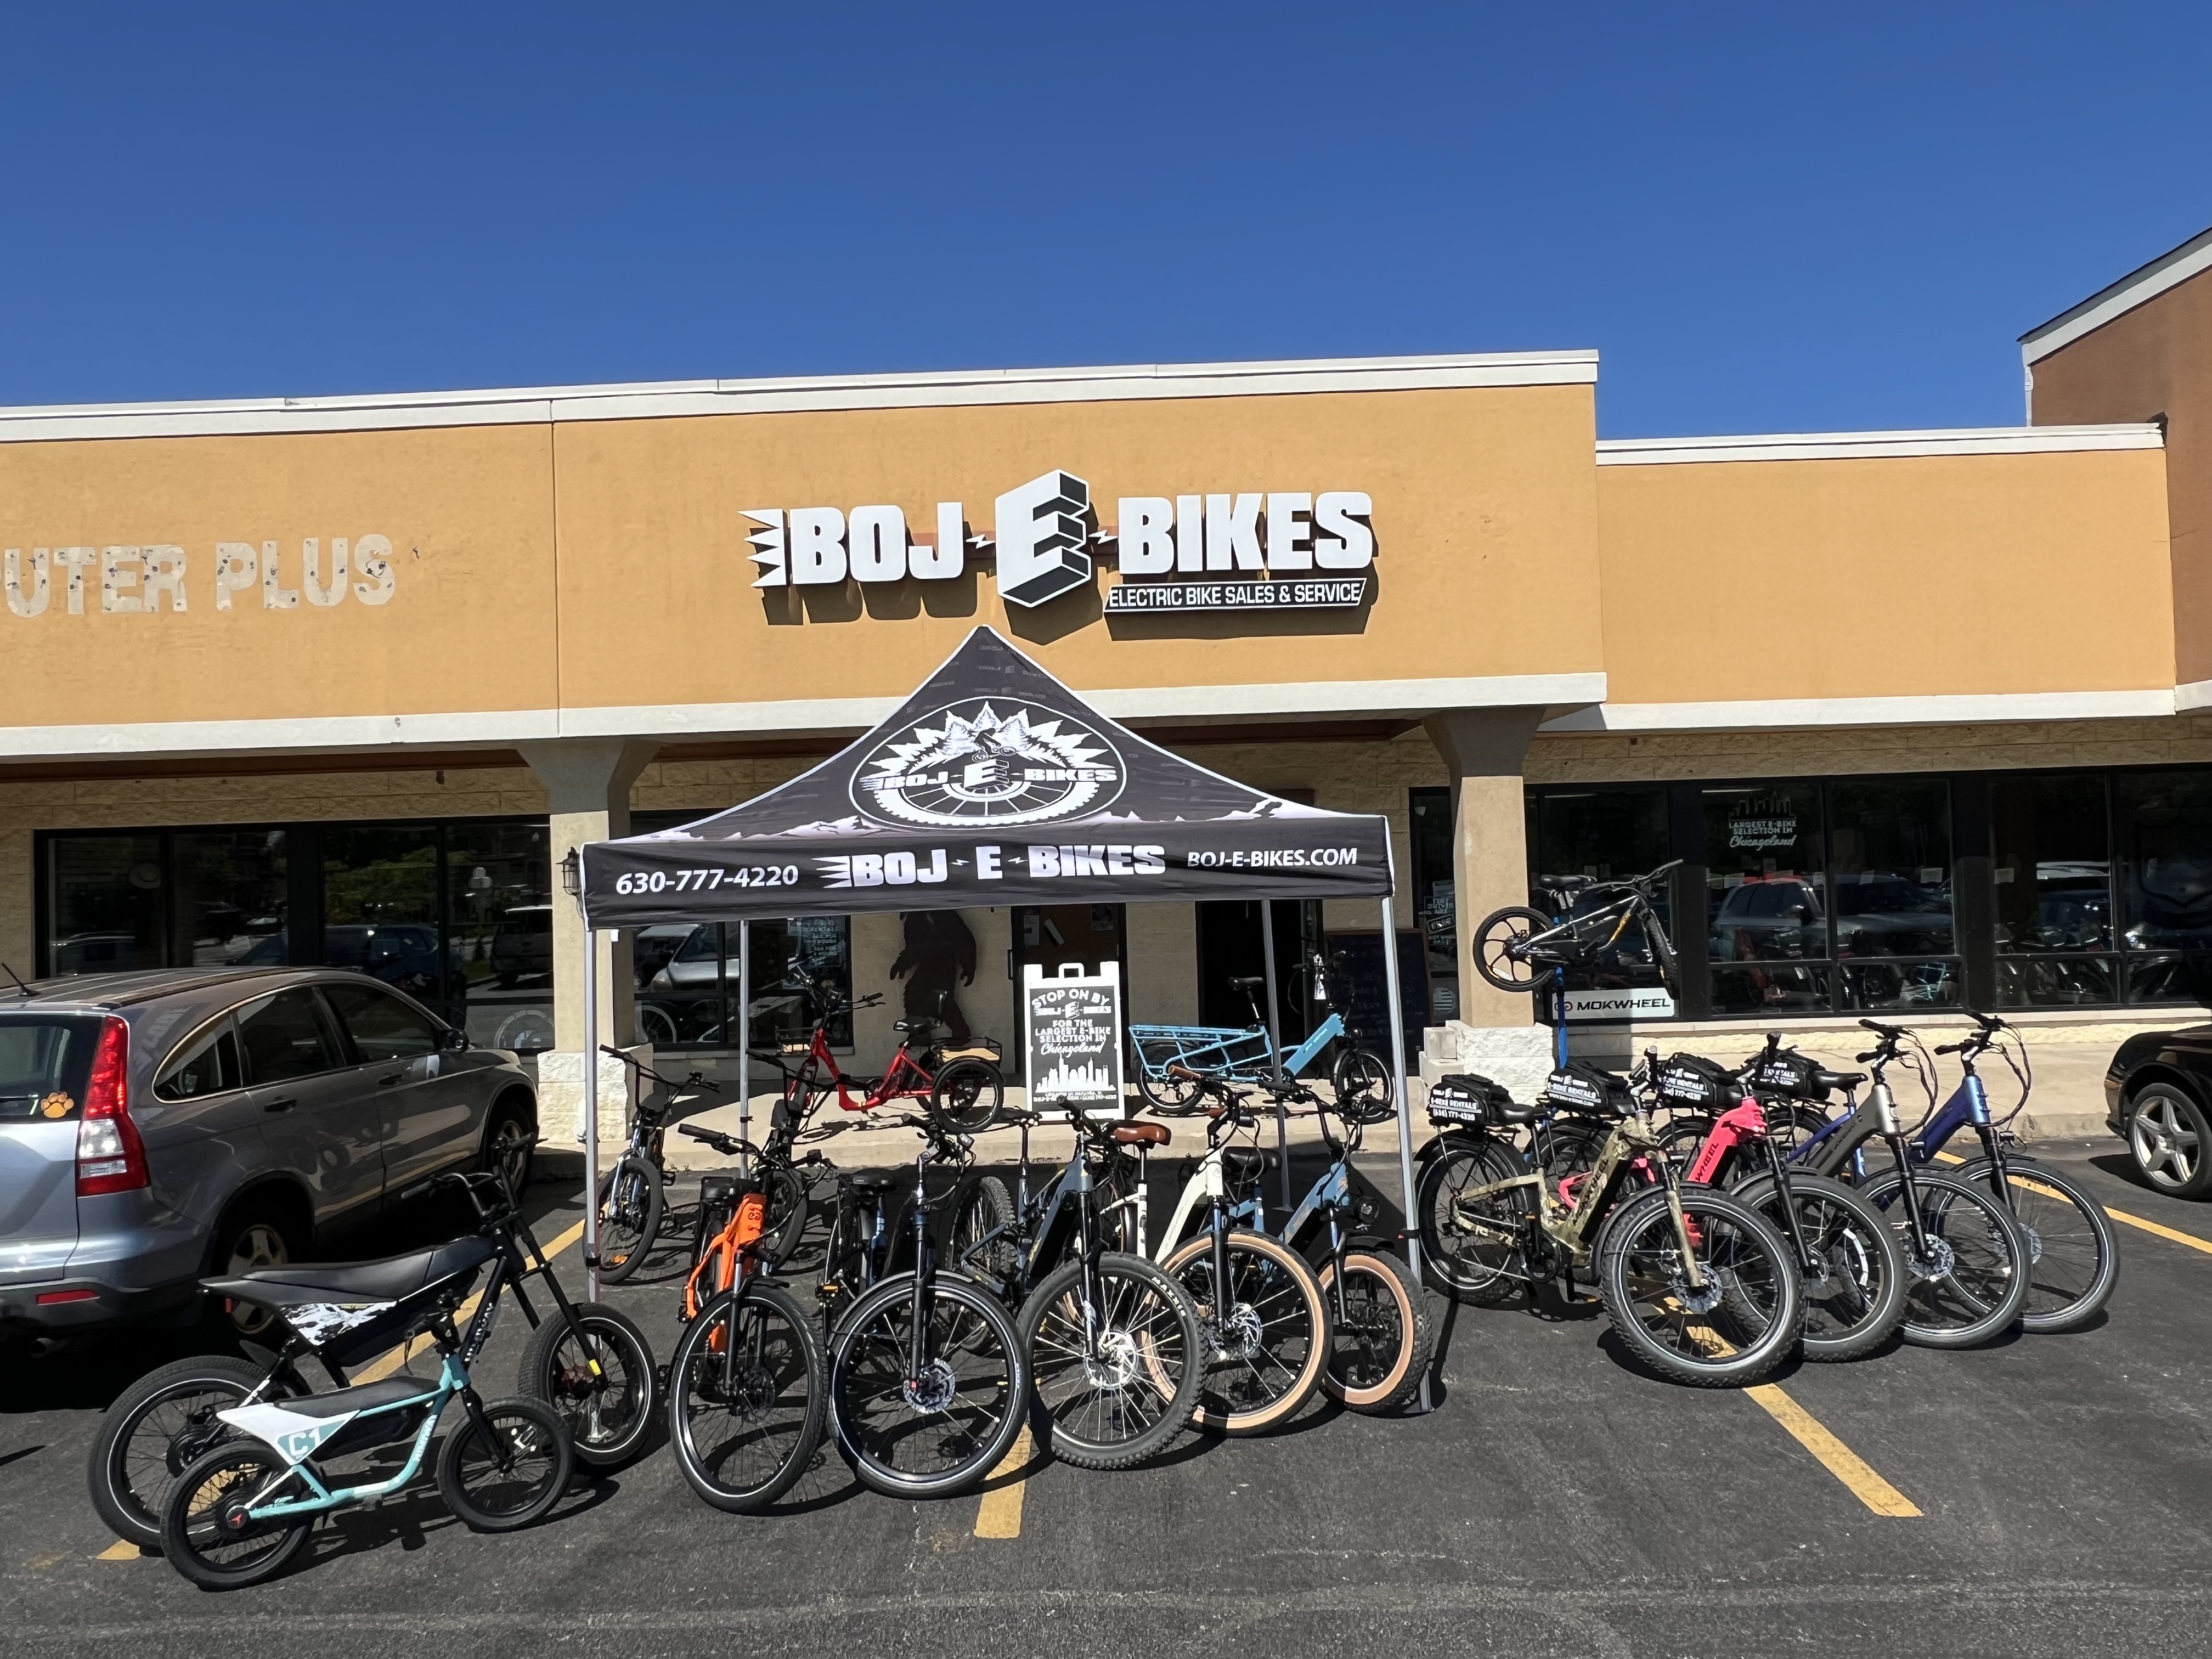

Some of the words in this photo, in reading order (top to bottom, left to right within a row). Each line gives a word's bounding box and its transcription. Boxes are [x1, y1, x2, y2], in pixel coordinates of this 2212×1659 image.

[789, 502, 964, 585] BOJ
[995, 470, 1091, 607] E
[1119, 492, 1373, 574] BIKES
[0, 545, 188, 618] UTER
[216, 534, 396, 611] PLUS
[1109, 587, 1182, 607] ELECTRIC
[1186, 586, 1222, 605] BIKE
[1225, 585, 1275, 605] SALES
[1279, 585, 1291, 603] &
[1294, 583, 1361, 602] SERVICE
[884, 771, 949, 789] BOJ
[1024, 768, 1118, 782] BIKES
[1729, 821, 1767, 829] LARGEST
[616, 865, 799, 895] 630-777-4220
[853, 849, 947, 887] BOJ
[975, 845, 1003, 879] E
[1028, 845, 1166, 878] BIKES
[1187, 848, 1358, 868] BOJ-E-BIKES.COM
[1031, 989, 1066, 1009] STOP
[1069, 988, 1090, 1001] ON
[1091, 992, 1110, 1006] BY
[1577, 998, 1671, 1011] MOKWHEEL
[1035, 1027, 1077, 1036] LARGEST
[1080, 1026, 1111, 1035] E-BIKE
[1052, 1019, 1073, 1028] FOR
[1074, 1019, 1093, 1027] THE
[1040, 1034, 1092, 1043] SELECTION
[1095, 1034, 1106, 1042] IN
[1041, 1042, 1105, 1058] Chicagoland
[1695, 1143, 1719, 1182] WHEEL
[288, 1426, 320, 1457] C1
